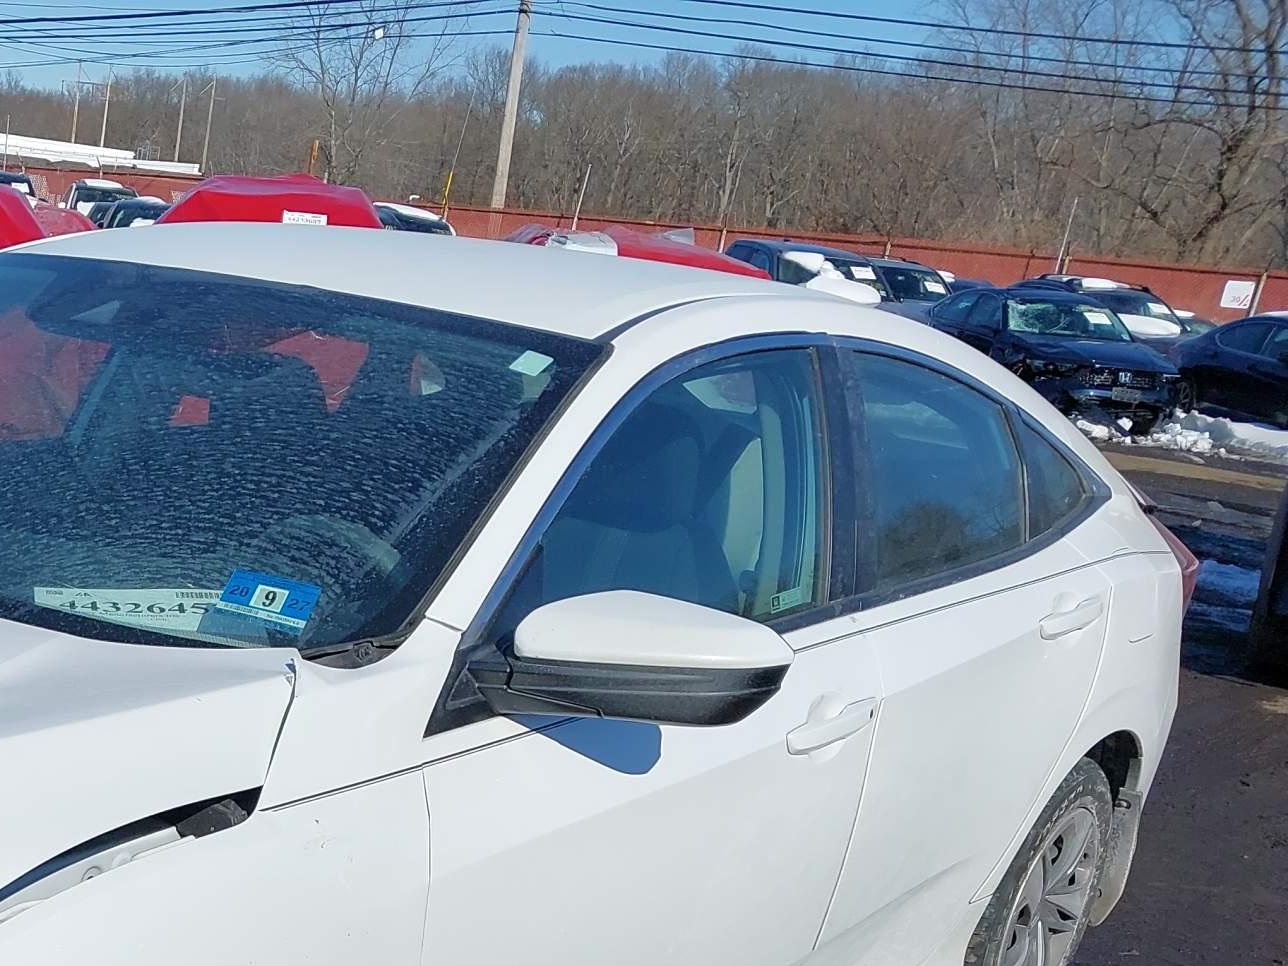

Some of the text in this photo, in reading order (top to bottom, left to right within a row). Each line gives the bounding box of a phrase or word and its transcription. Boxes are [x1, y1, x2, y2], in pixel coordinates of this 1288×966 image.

[229, 585, 310, 611] 20 9 27
